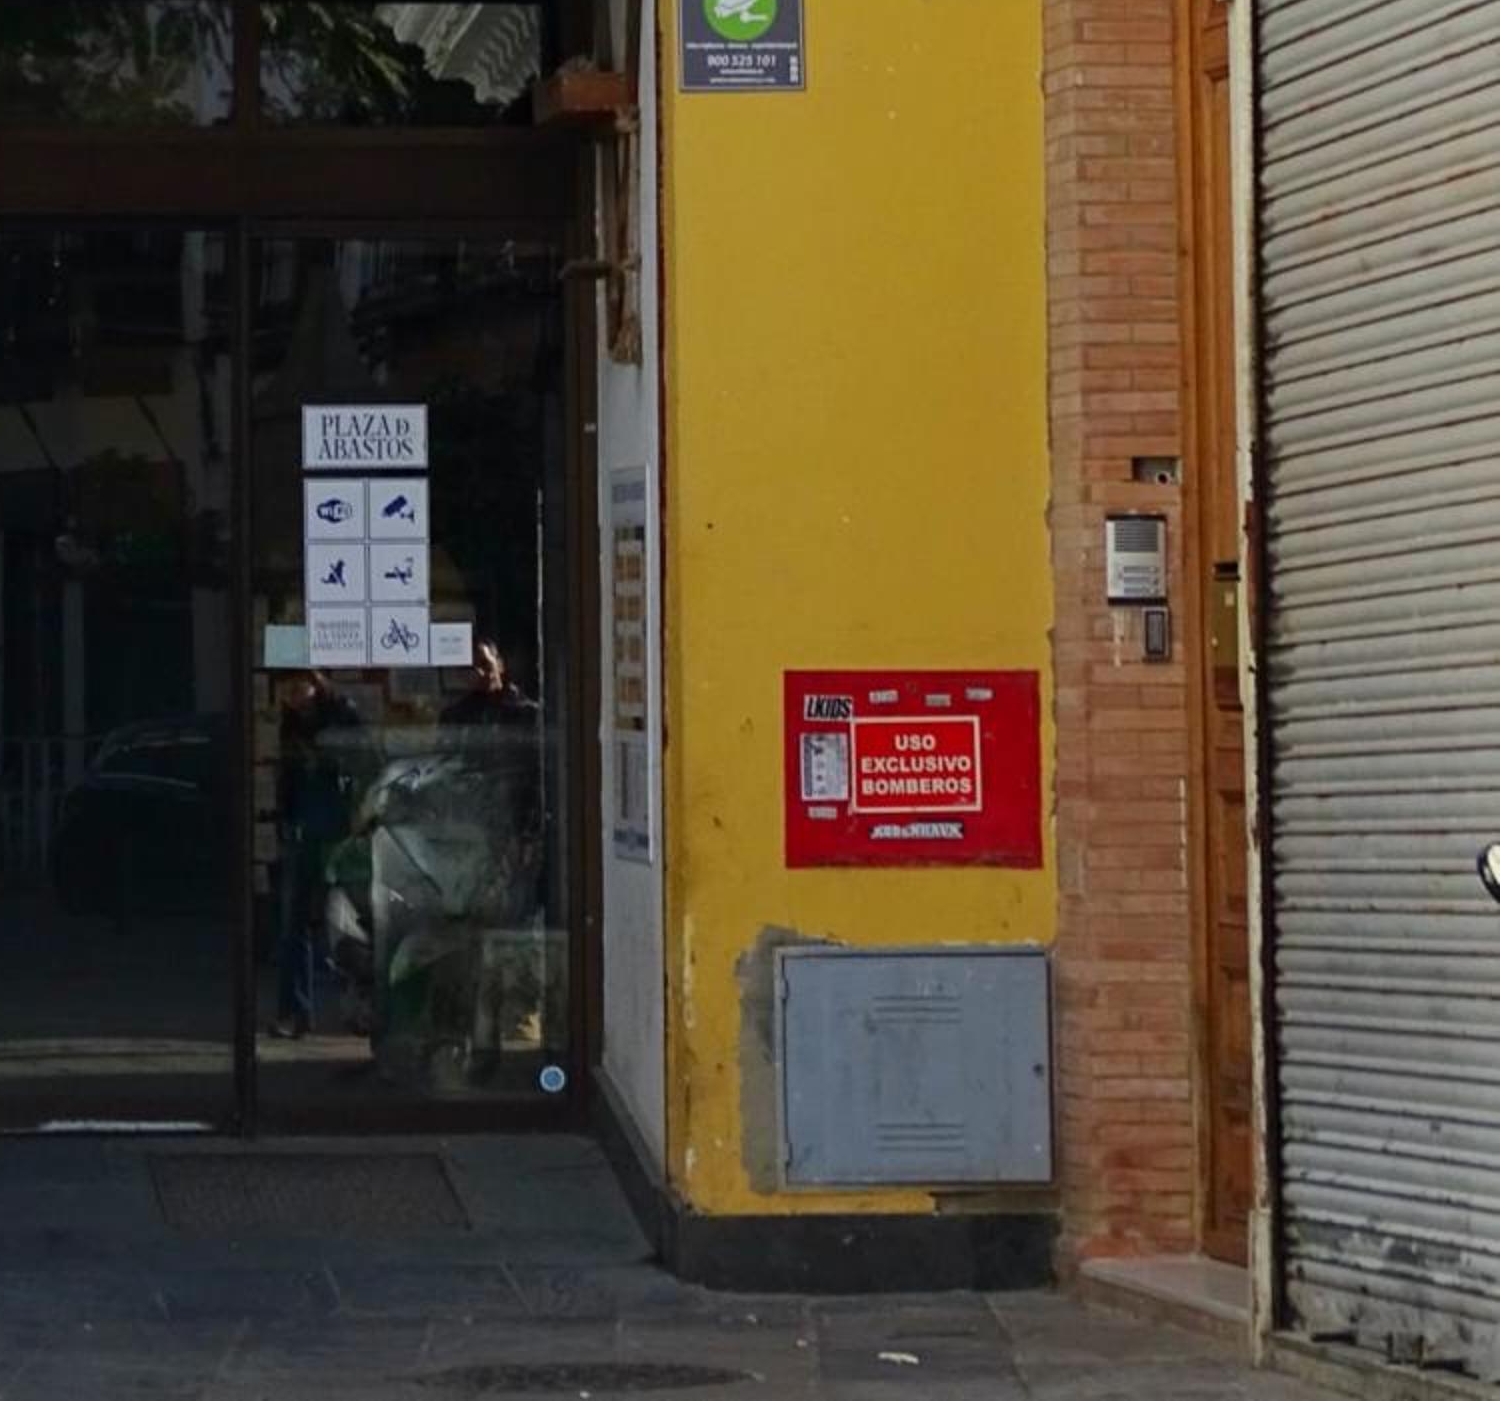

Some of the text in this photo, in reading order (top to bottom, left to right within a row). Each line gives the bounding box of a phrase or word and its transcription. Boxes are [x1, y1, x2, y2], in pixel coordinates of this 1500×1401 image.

[322, 414, 390, 437] PLAZA
[318, 438, 414, 460] ABASTOS
[895, 734, 937, 751] USO
[861, 755, 972, 774] EXCLUSIVO
[861, 777, 973, 796] BOMBEROS
